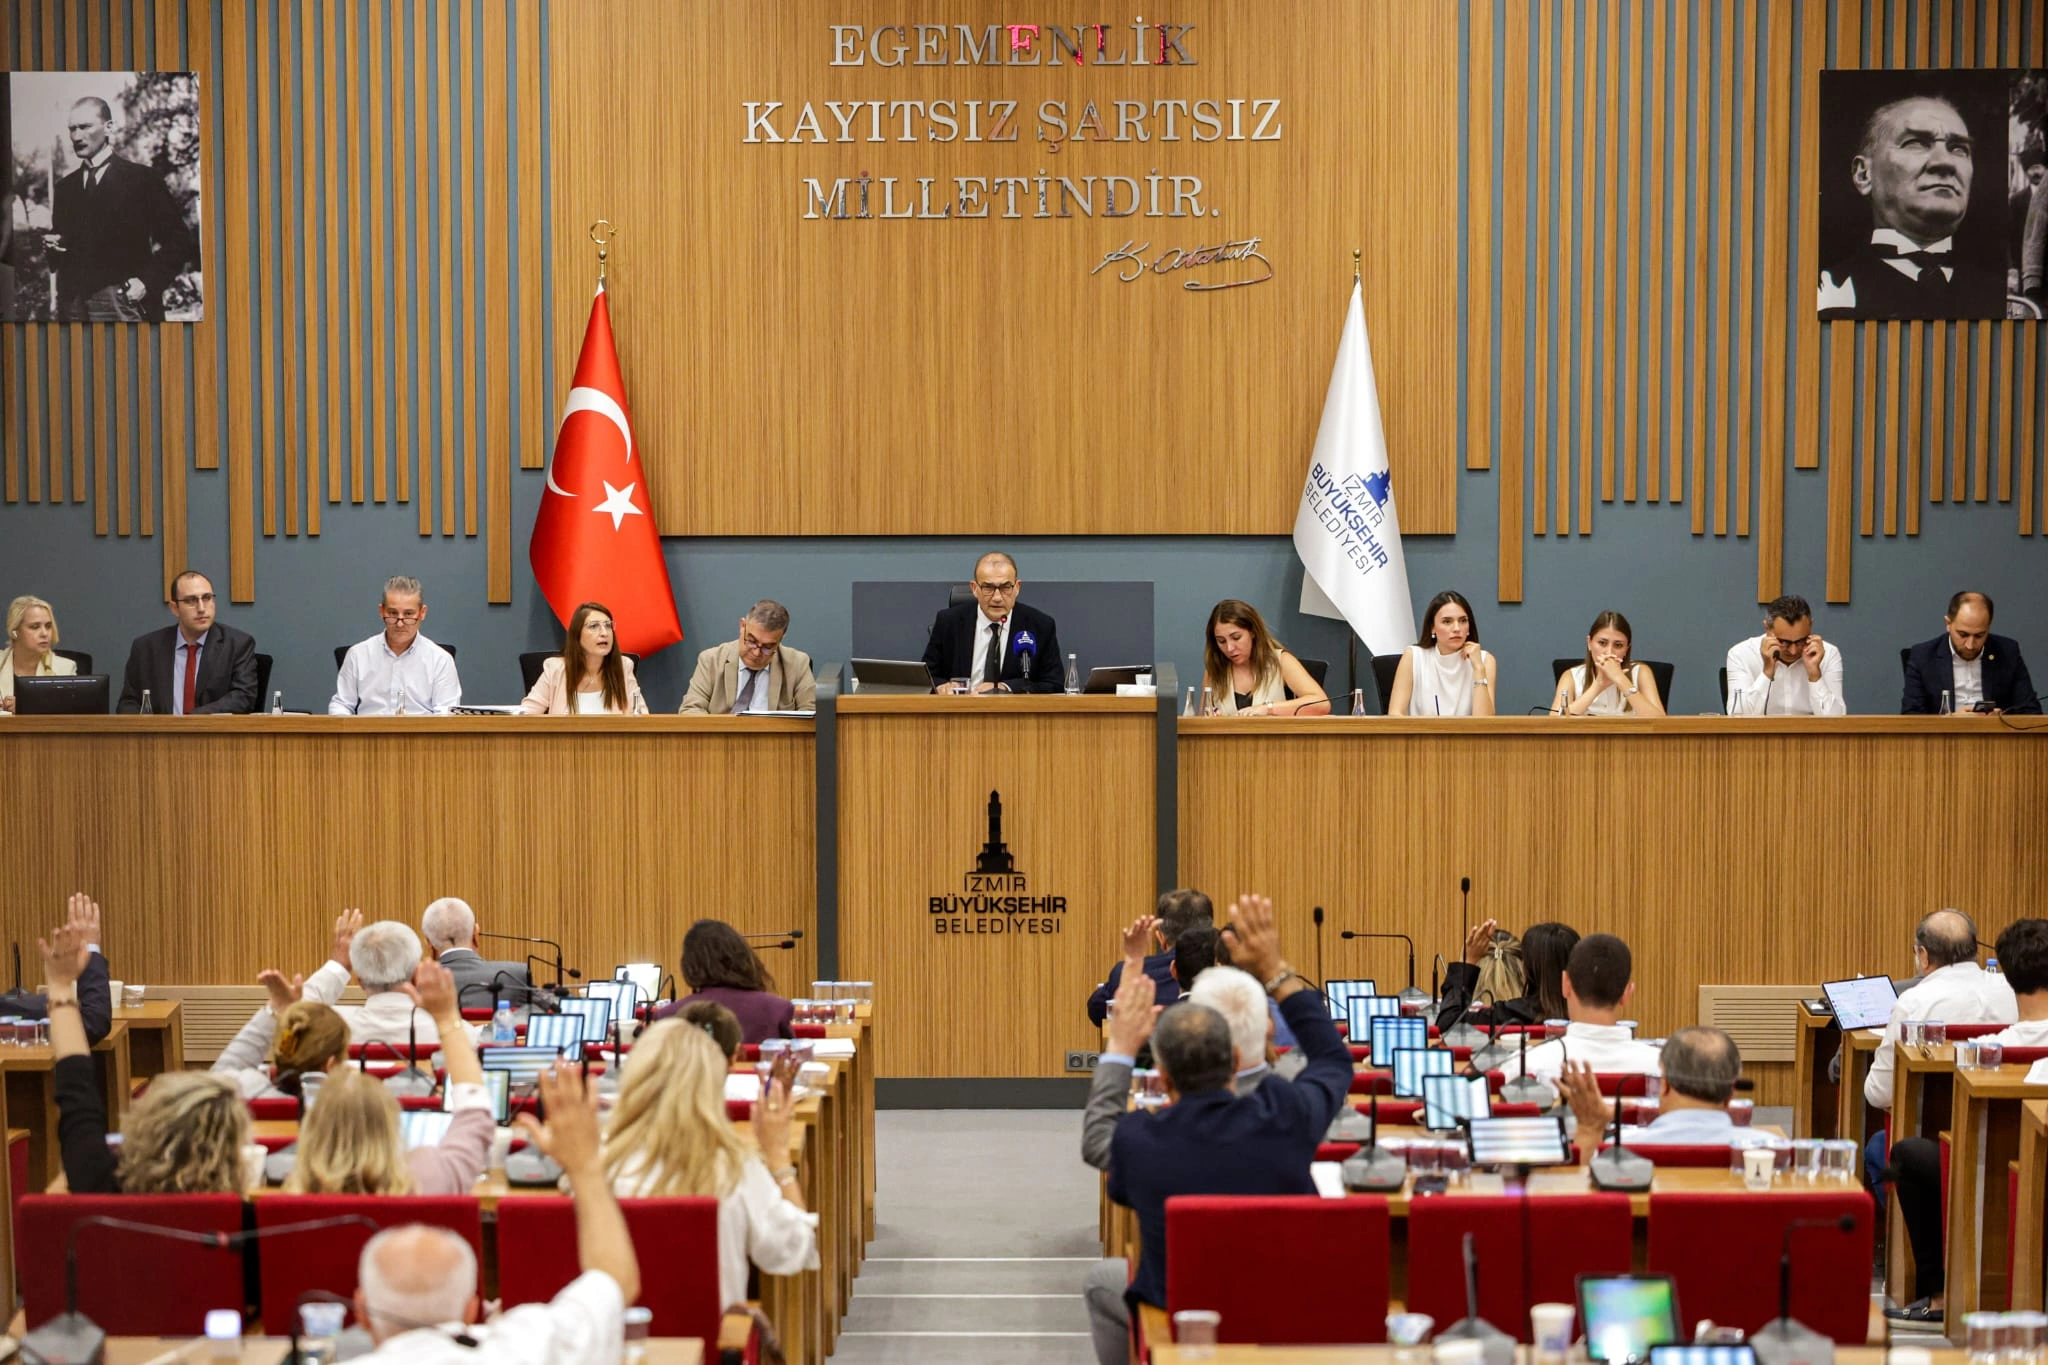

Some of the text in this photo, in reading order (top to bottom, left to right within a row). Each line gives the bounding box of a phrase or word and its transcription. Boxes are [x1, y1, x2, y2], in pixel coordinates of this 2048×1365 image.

[828, 16, 1199, 67] EGEMENLİK
[742, 99, 1282, 153] KAYITSIZ ŞARTSIZ
[803, 168, 1220, 219] MİLLETİNDİR.
[929, 893, 1067, 917] BÜYÜKŞEHİR
